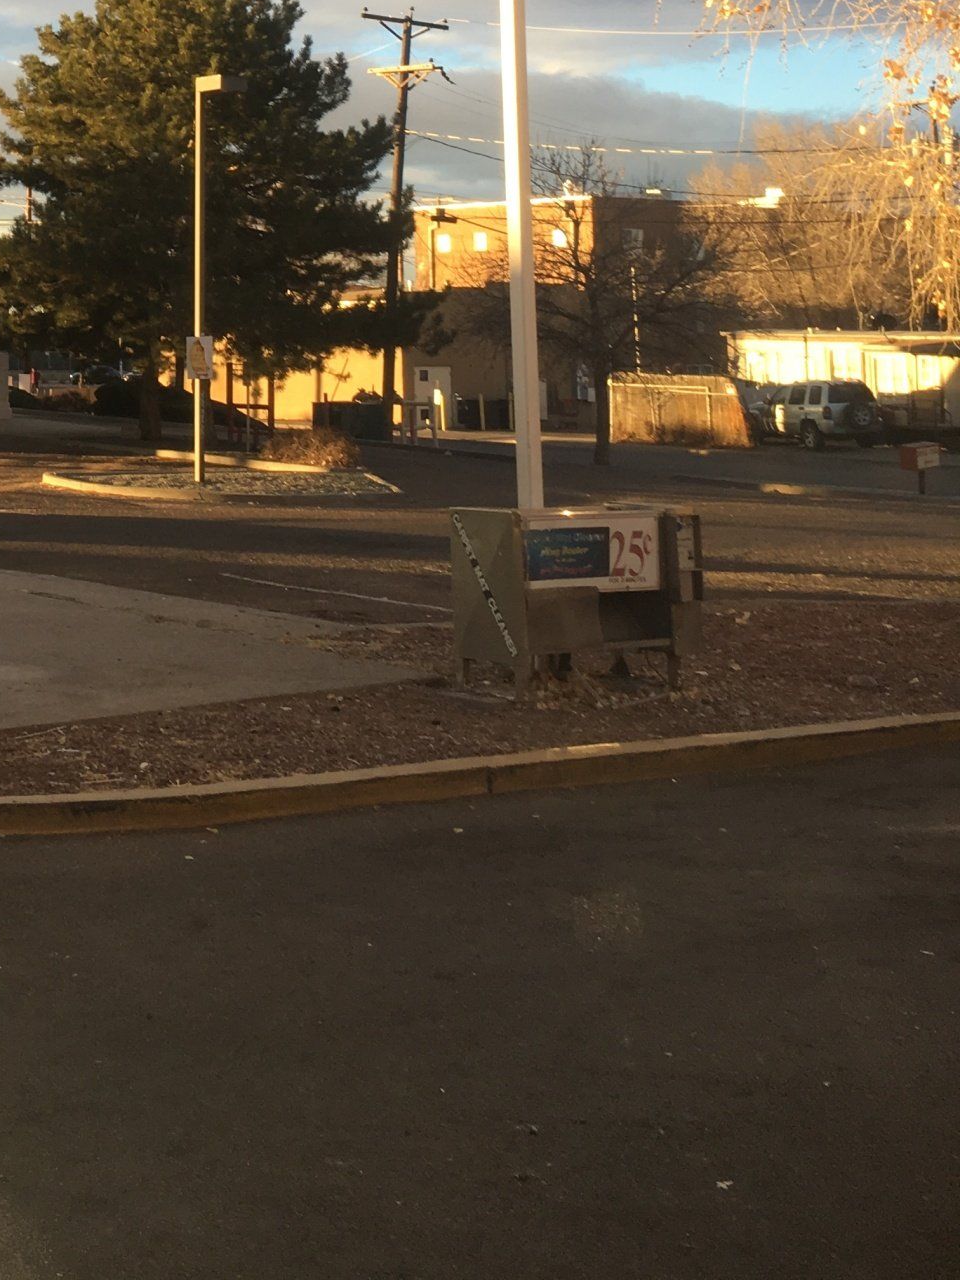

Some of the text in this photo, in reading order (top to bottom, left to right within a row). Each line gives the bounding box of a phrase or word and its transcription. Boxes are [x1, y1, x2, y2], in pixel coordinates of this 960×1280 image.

[452, 513, 518, 658] CARPET MAT CLEANER
